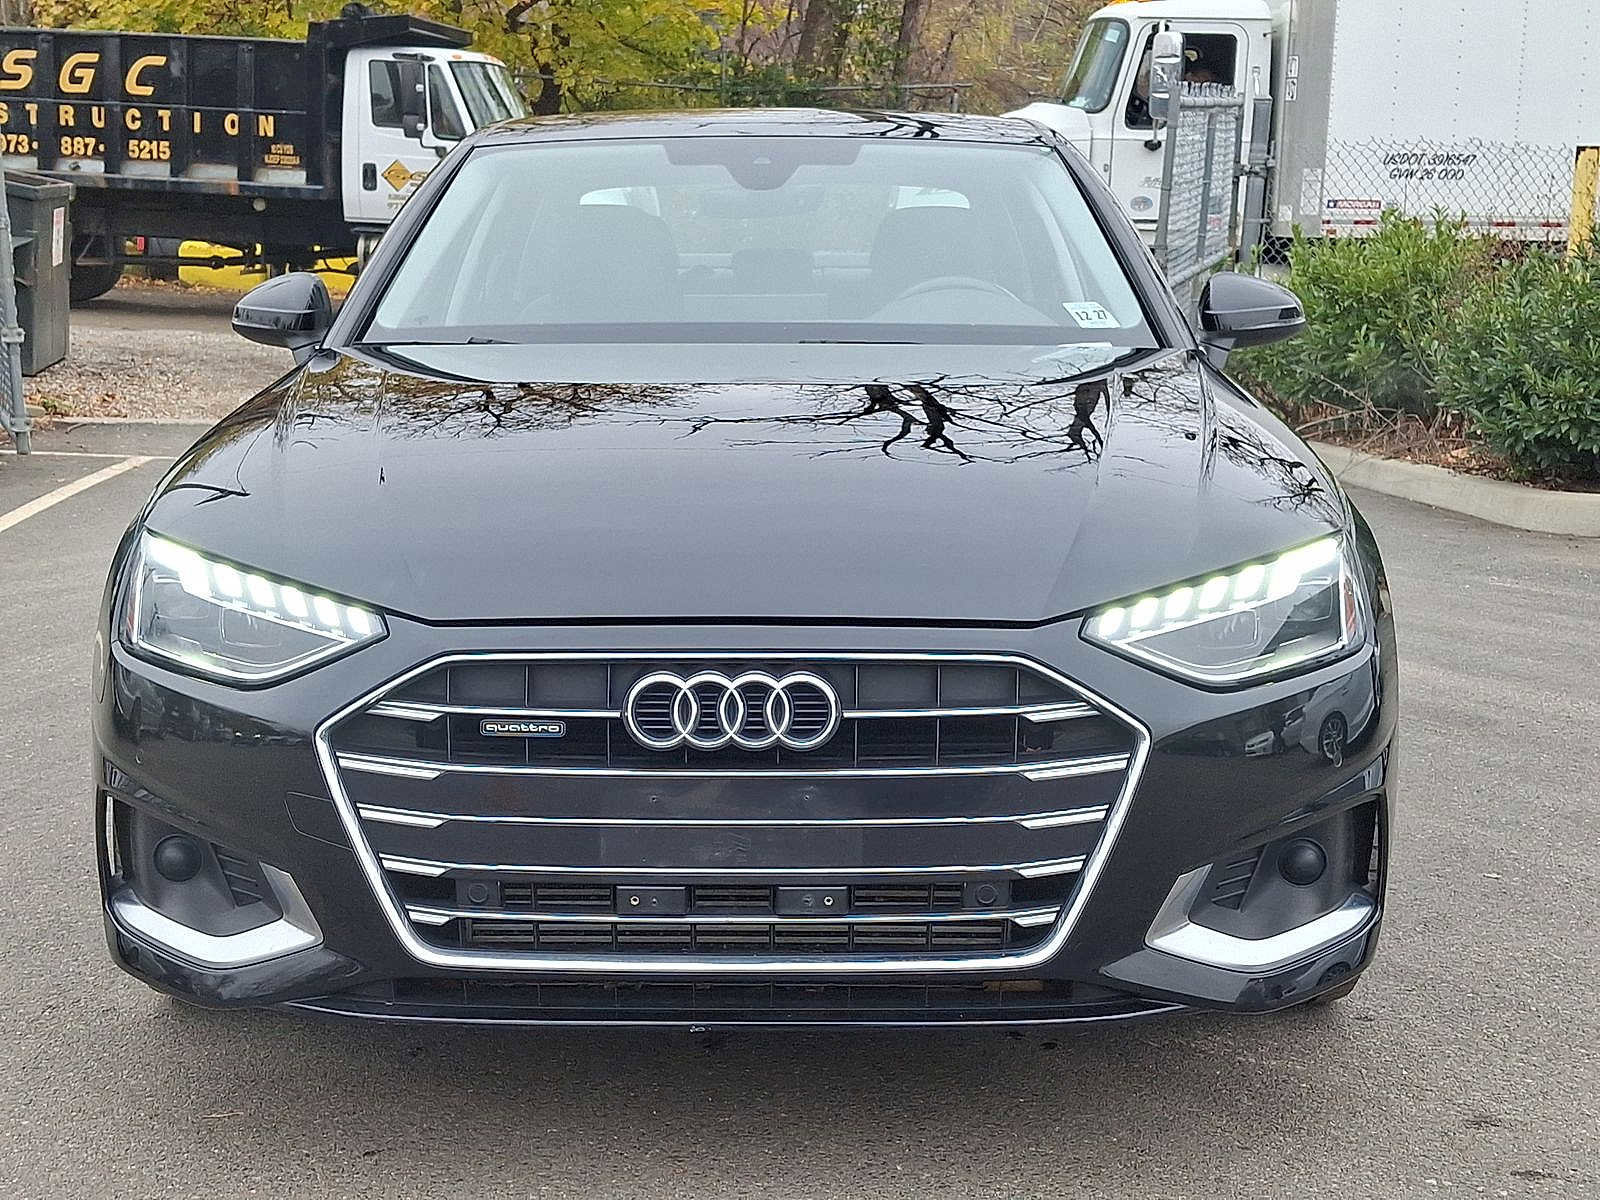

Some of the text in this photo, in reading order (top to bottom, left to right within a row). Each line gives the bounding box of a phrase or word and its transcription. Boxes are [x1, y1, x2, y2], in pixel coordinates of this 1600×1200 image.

[128, 139, 171, 160] 5215
[1383, 153, 1426, 166] USDOT
[1438, 168, 1464, 180] 000
[485, 723, 560, 733] quattro
